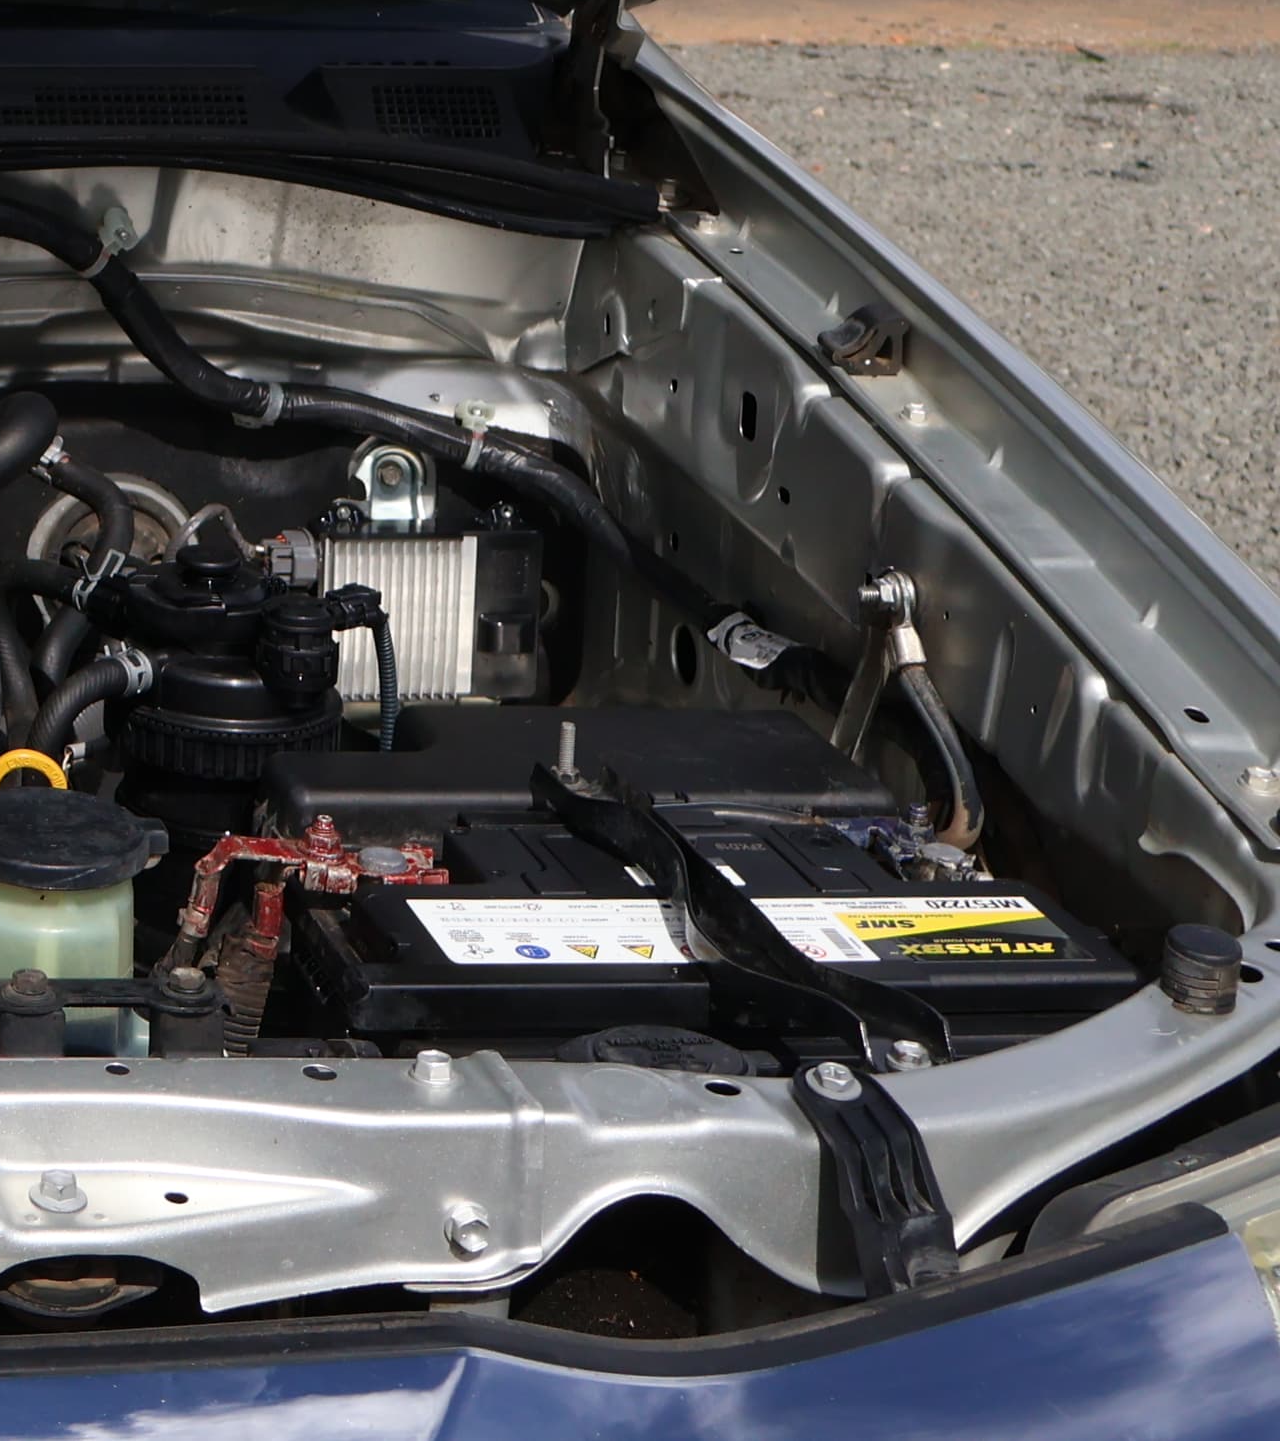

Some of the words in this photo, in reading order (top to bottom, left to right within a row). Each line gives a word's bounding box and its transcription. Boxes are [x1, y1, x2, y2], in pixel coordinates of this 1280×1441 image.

[924, 899, 1023, 910] MF57220
[855, 919, 916, 929] SMF
[897, 941, 1056, 955] ATLASBX
